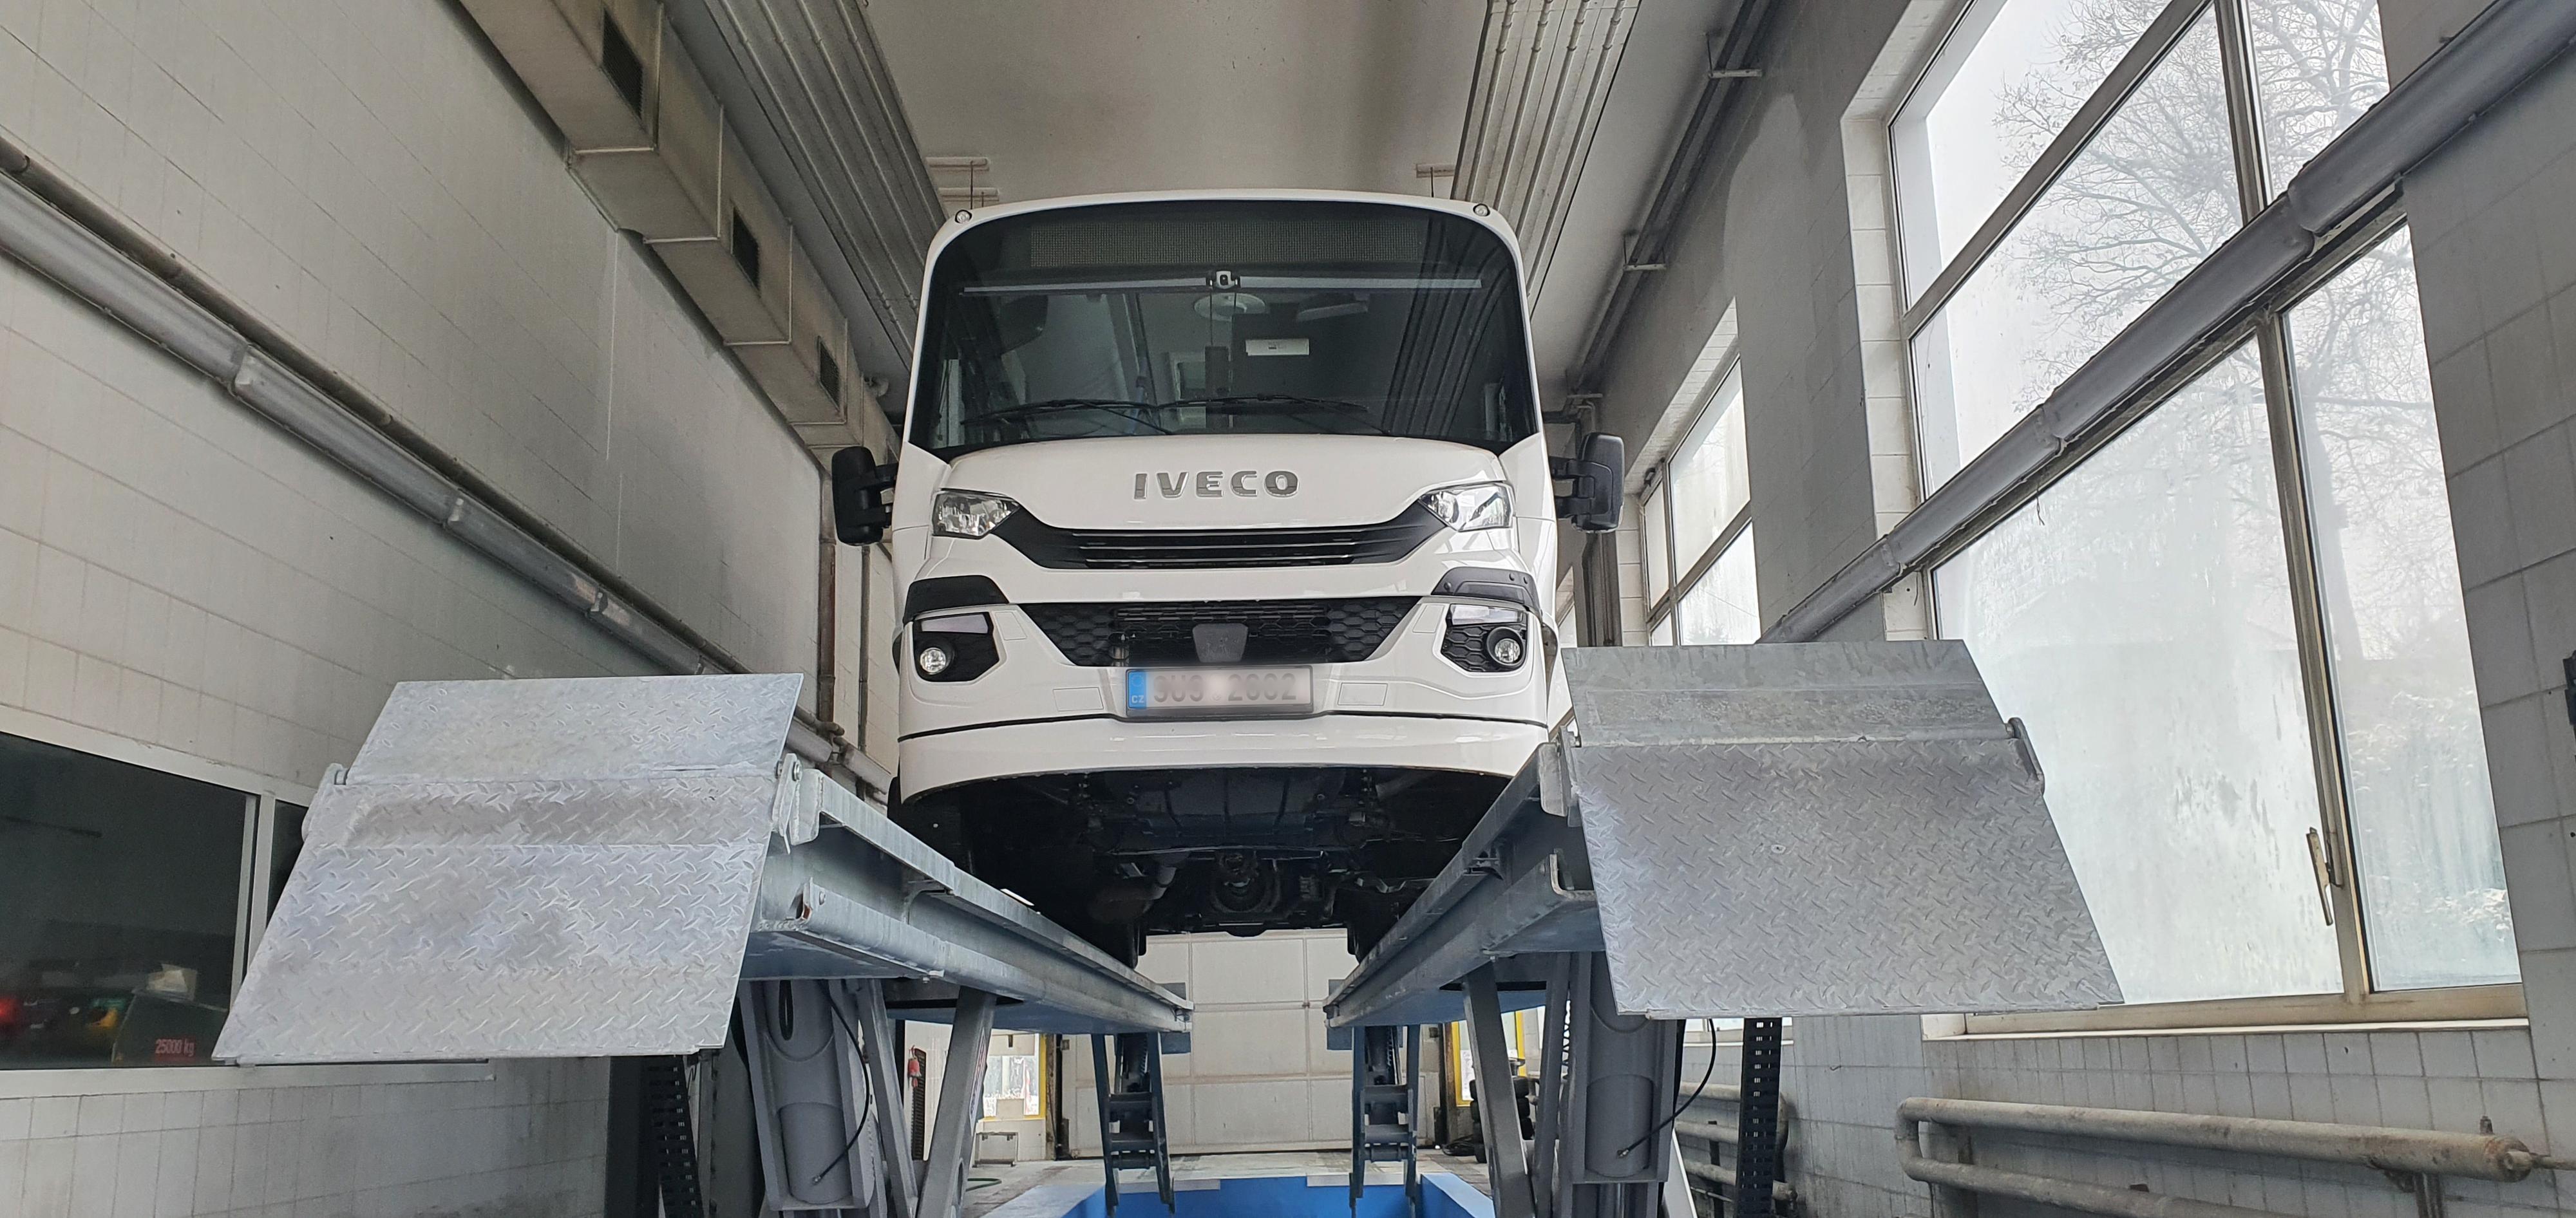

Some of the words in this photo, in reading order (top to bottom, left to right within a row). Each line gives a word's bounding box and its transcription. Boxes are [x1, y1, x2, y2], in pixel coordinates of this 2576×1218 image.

[1133, 471, 1300, 500] IVECO
[1132, 695, 1144, 704] CZ
[155, 1038, 182, 1054] 25000
[184, 1038, 194, 1057] kg
